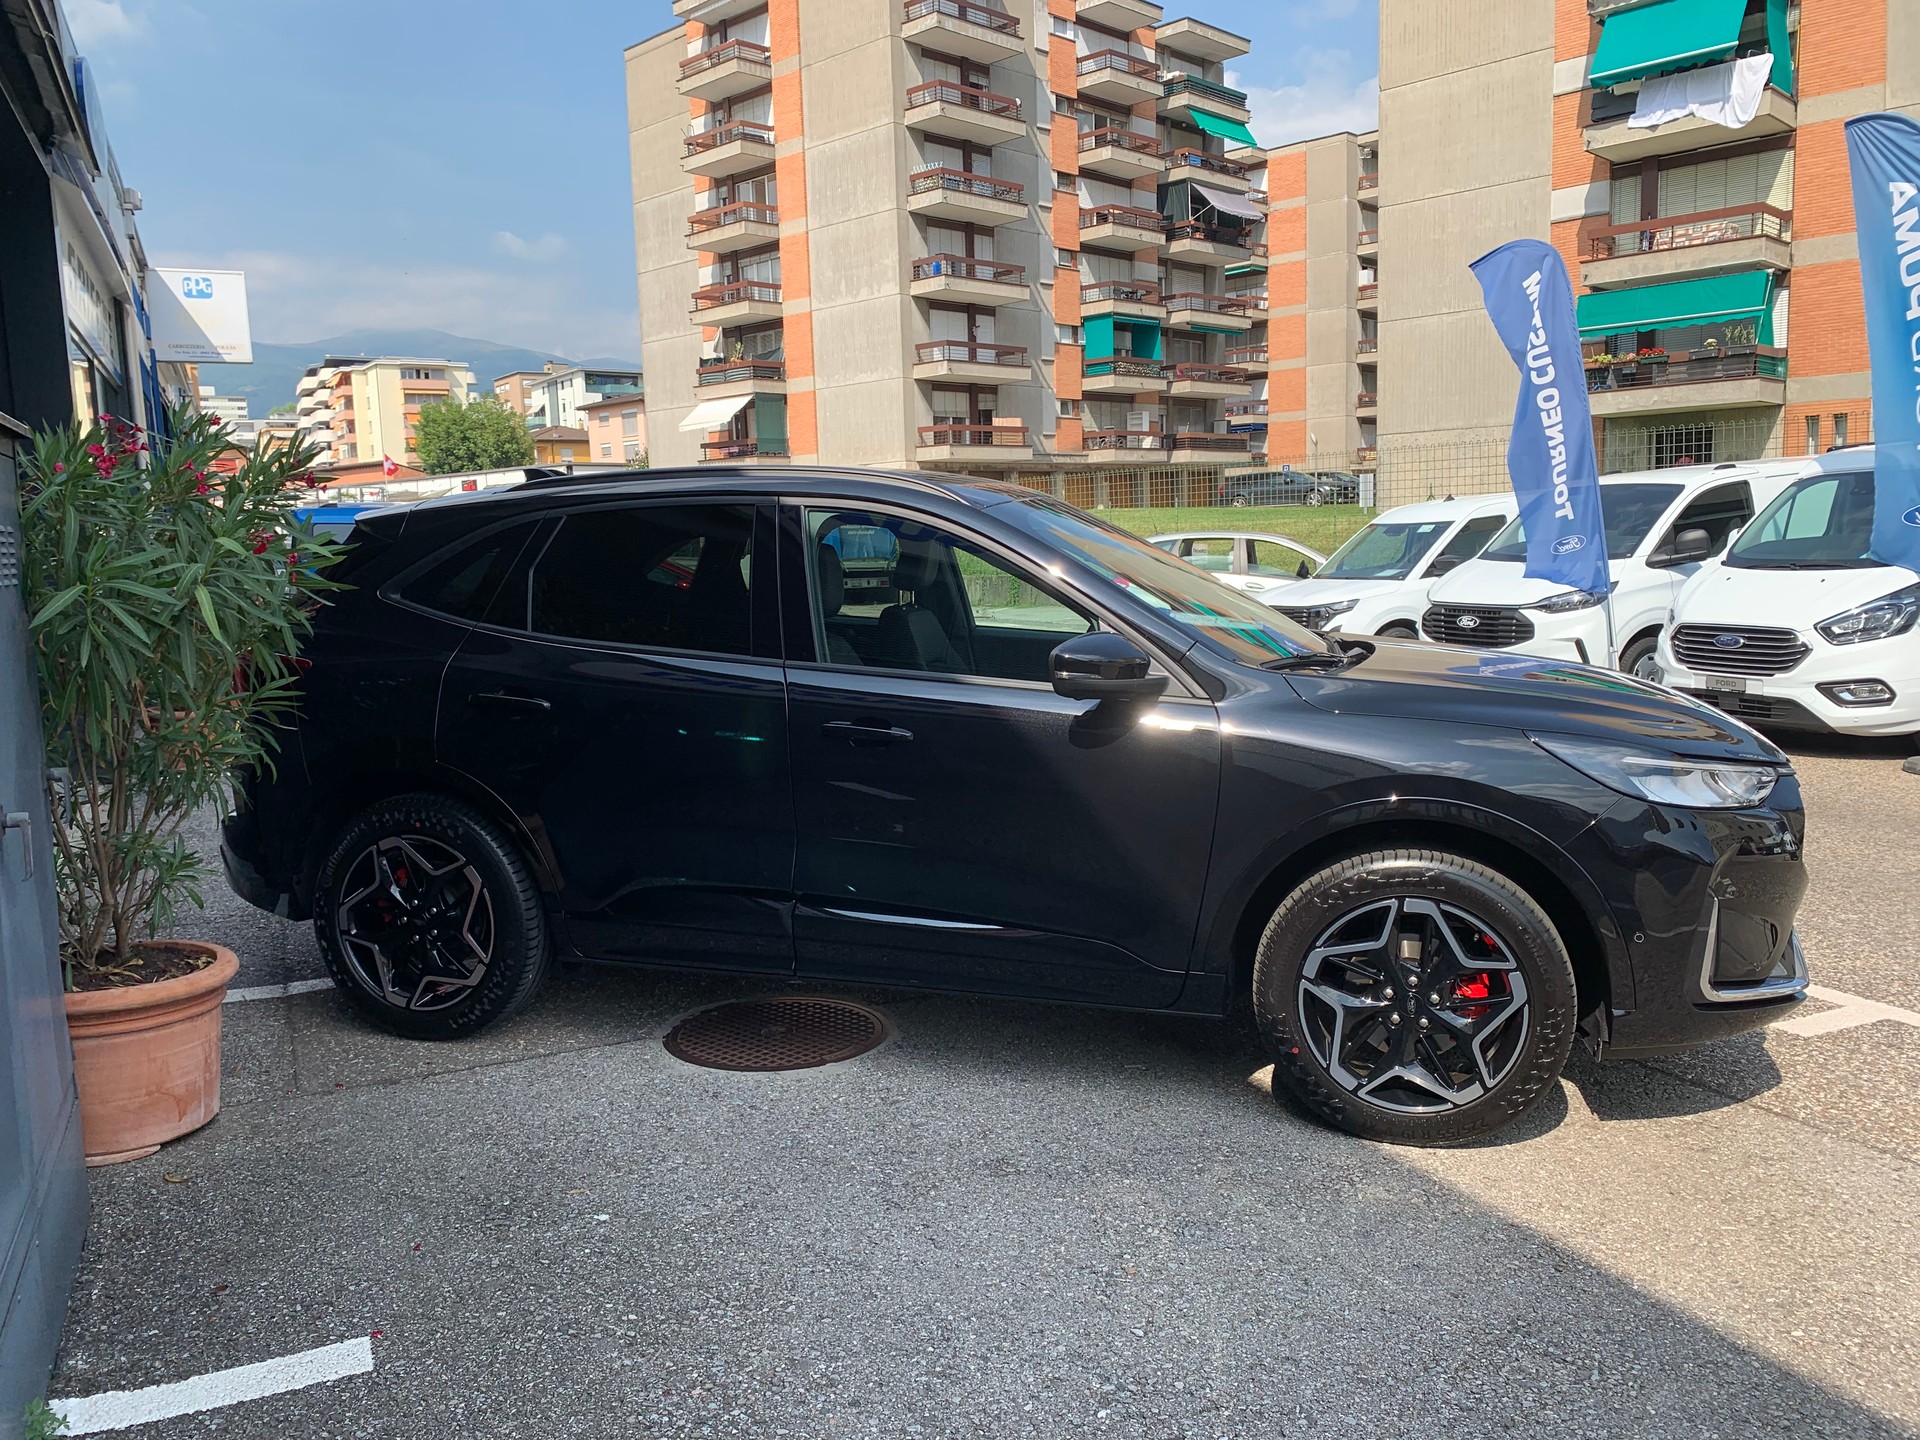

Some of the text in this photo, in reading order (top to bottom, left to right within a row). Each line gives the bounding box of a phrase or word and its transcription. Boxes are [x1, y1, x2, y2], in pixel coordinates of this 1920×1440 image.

[183, 277, 212, 296] PPG
[1459, 616, 1477, 627] Ford
[1715, 679, 1737, 688] FORD
